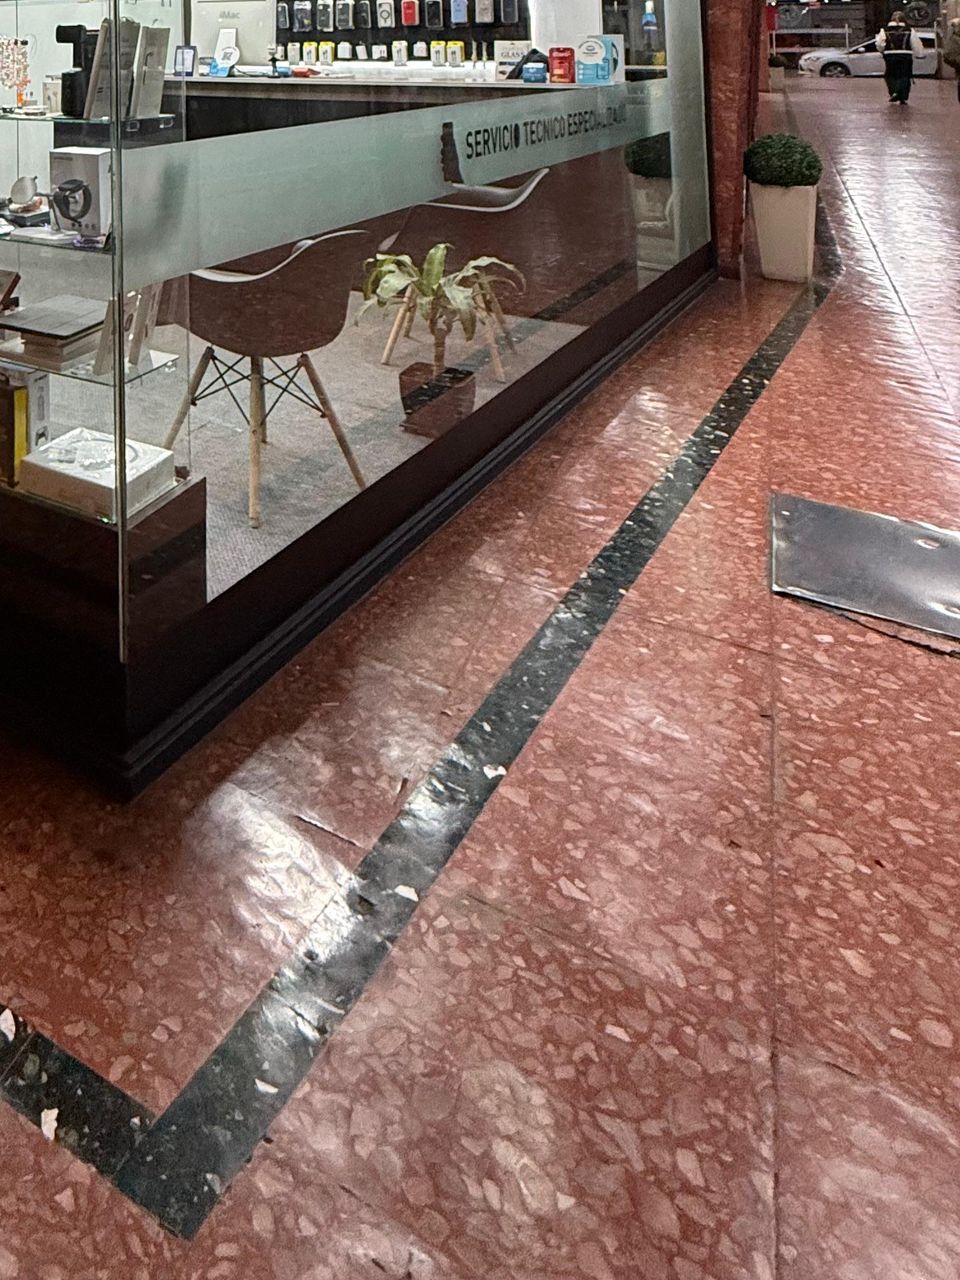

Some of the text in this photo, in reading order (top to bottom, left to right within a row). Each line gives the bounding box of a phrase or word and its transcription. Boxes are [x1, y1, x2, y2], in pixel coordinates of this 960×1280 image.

[219, 10, 241, 20] iMac
[465, 123, 521, 160] SERVICIO
[523, 115, 566, 147] TECNICO
